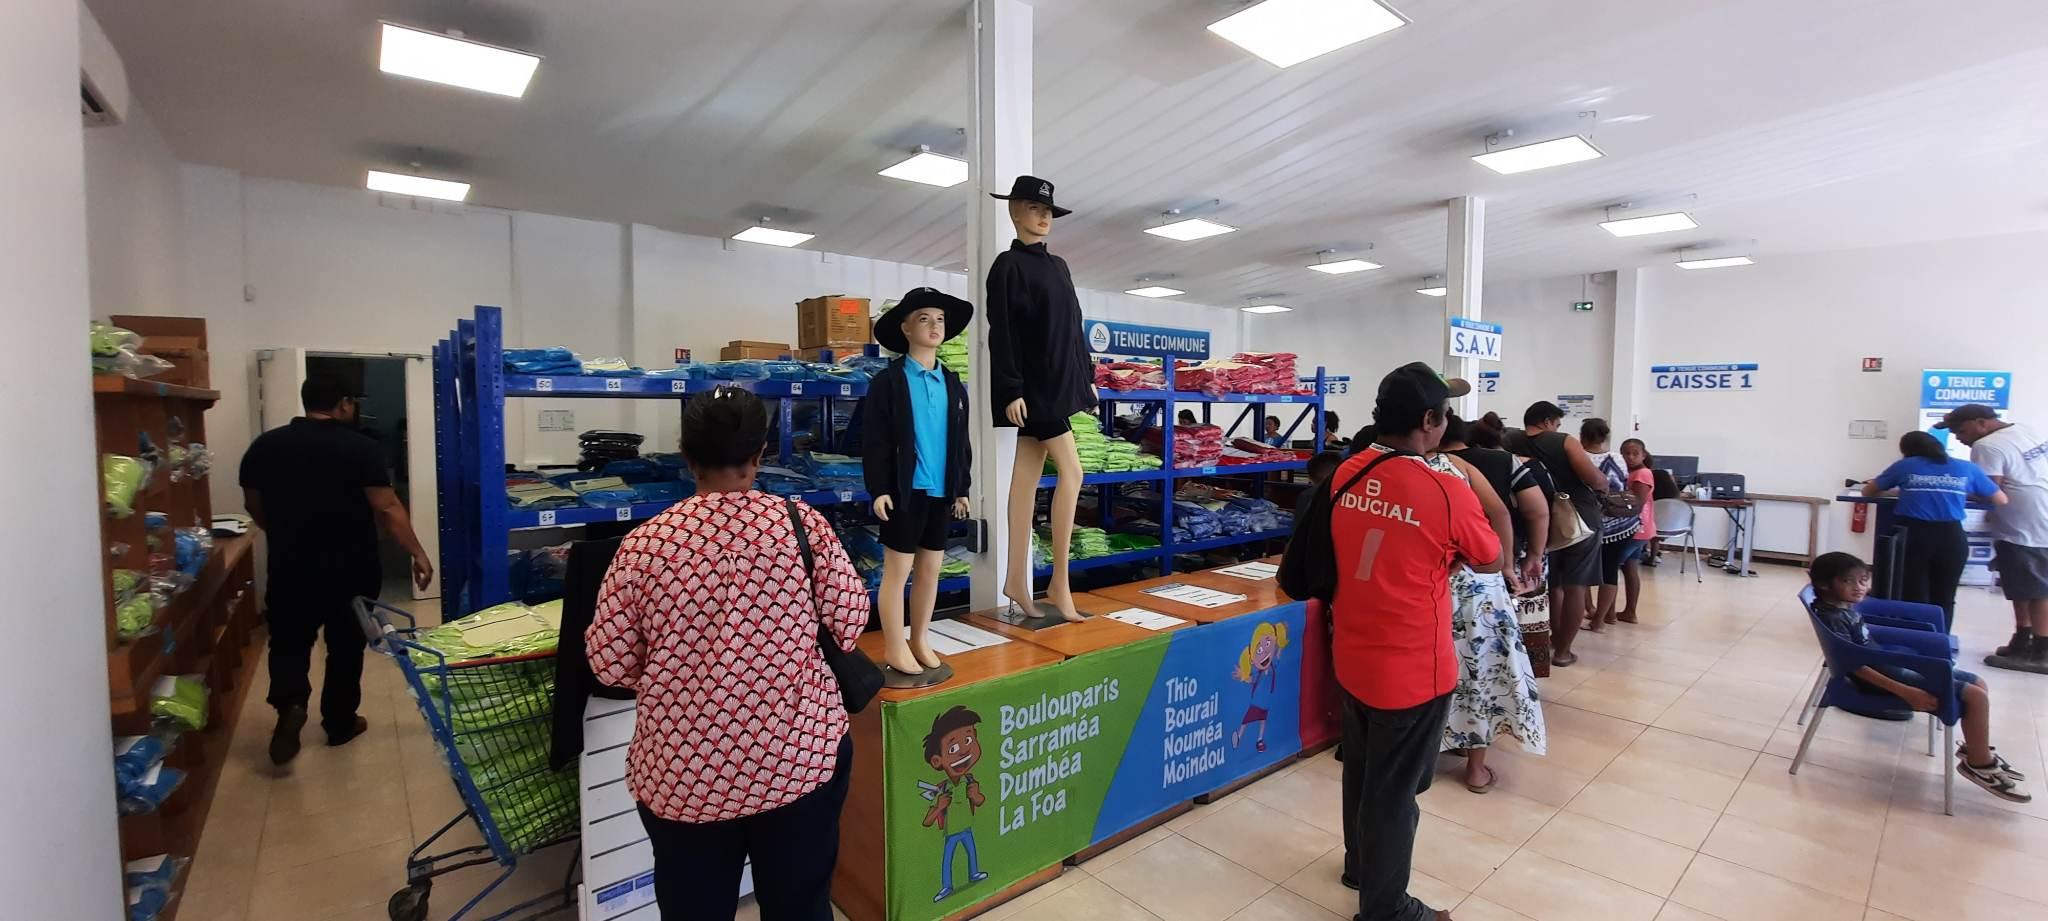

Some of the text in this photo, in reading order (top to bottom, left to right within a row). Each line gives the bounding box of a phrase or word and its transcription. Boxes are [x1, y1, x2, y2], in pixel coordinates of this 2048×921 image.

[1113, 330, 1206, 353] TENUE COMMUNE
[1455, 332, 1498, 357] S.A.V.
[673, 382, 684, 390] 62
[1339, 383, 1347, 394] 3
[1486, 380, 1496, 392] 2
[1656, 373, 1753, 389] CAISSE 1
[1935, 388, 1997, 401] COMMUNE
[1947, 376, 1986, 388] TENUE
[1334, 489, 1421, 527] IDUCIAL
[1165, 676, 1198, 705] Thio
[1000, 677, 1120, 736] Boulouparis
[1165, 691, 1219, 733] Bourail
[1000, 713, 1101, 769] Sarraméa
[1164, 720, 1223, 761] Nouméa
[1000, 750, 1083, 803] Dumbéa
[1162, 746, 1226, 789] Moindou
[1000, 789, 1067, 837] La Foa
